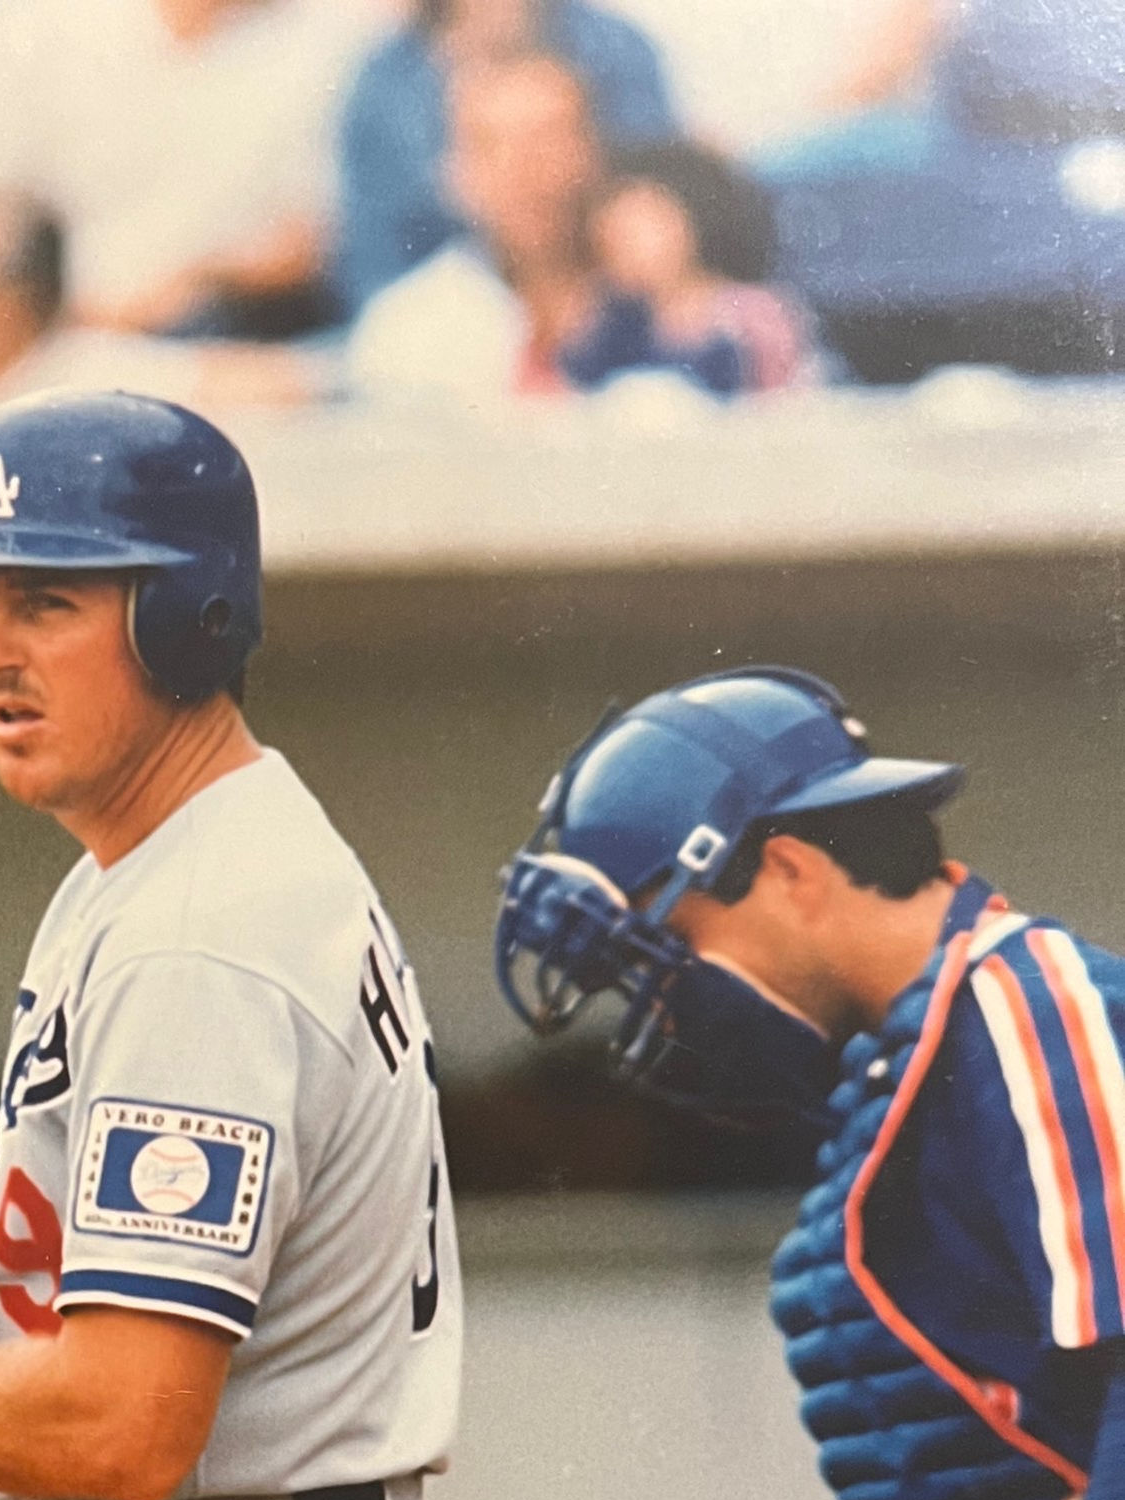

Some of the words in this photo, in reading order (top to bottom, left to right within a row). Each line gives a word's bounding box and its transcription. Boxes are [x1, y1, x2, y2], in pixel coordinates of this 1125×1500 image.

[103, 1106, 166, 1128] VERO
[179, 1117, 263, 1144] BEACH
[118, 1216, 243, 1246] ANNIVERSARY
